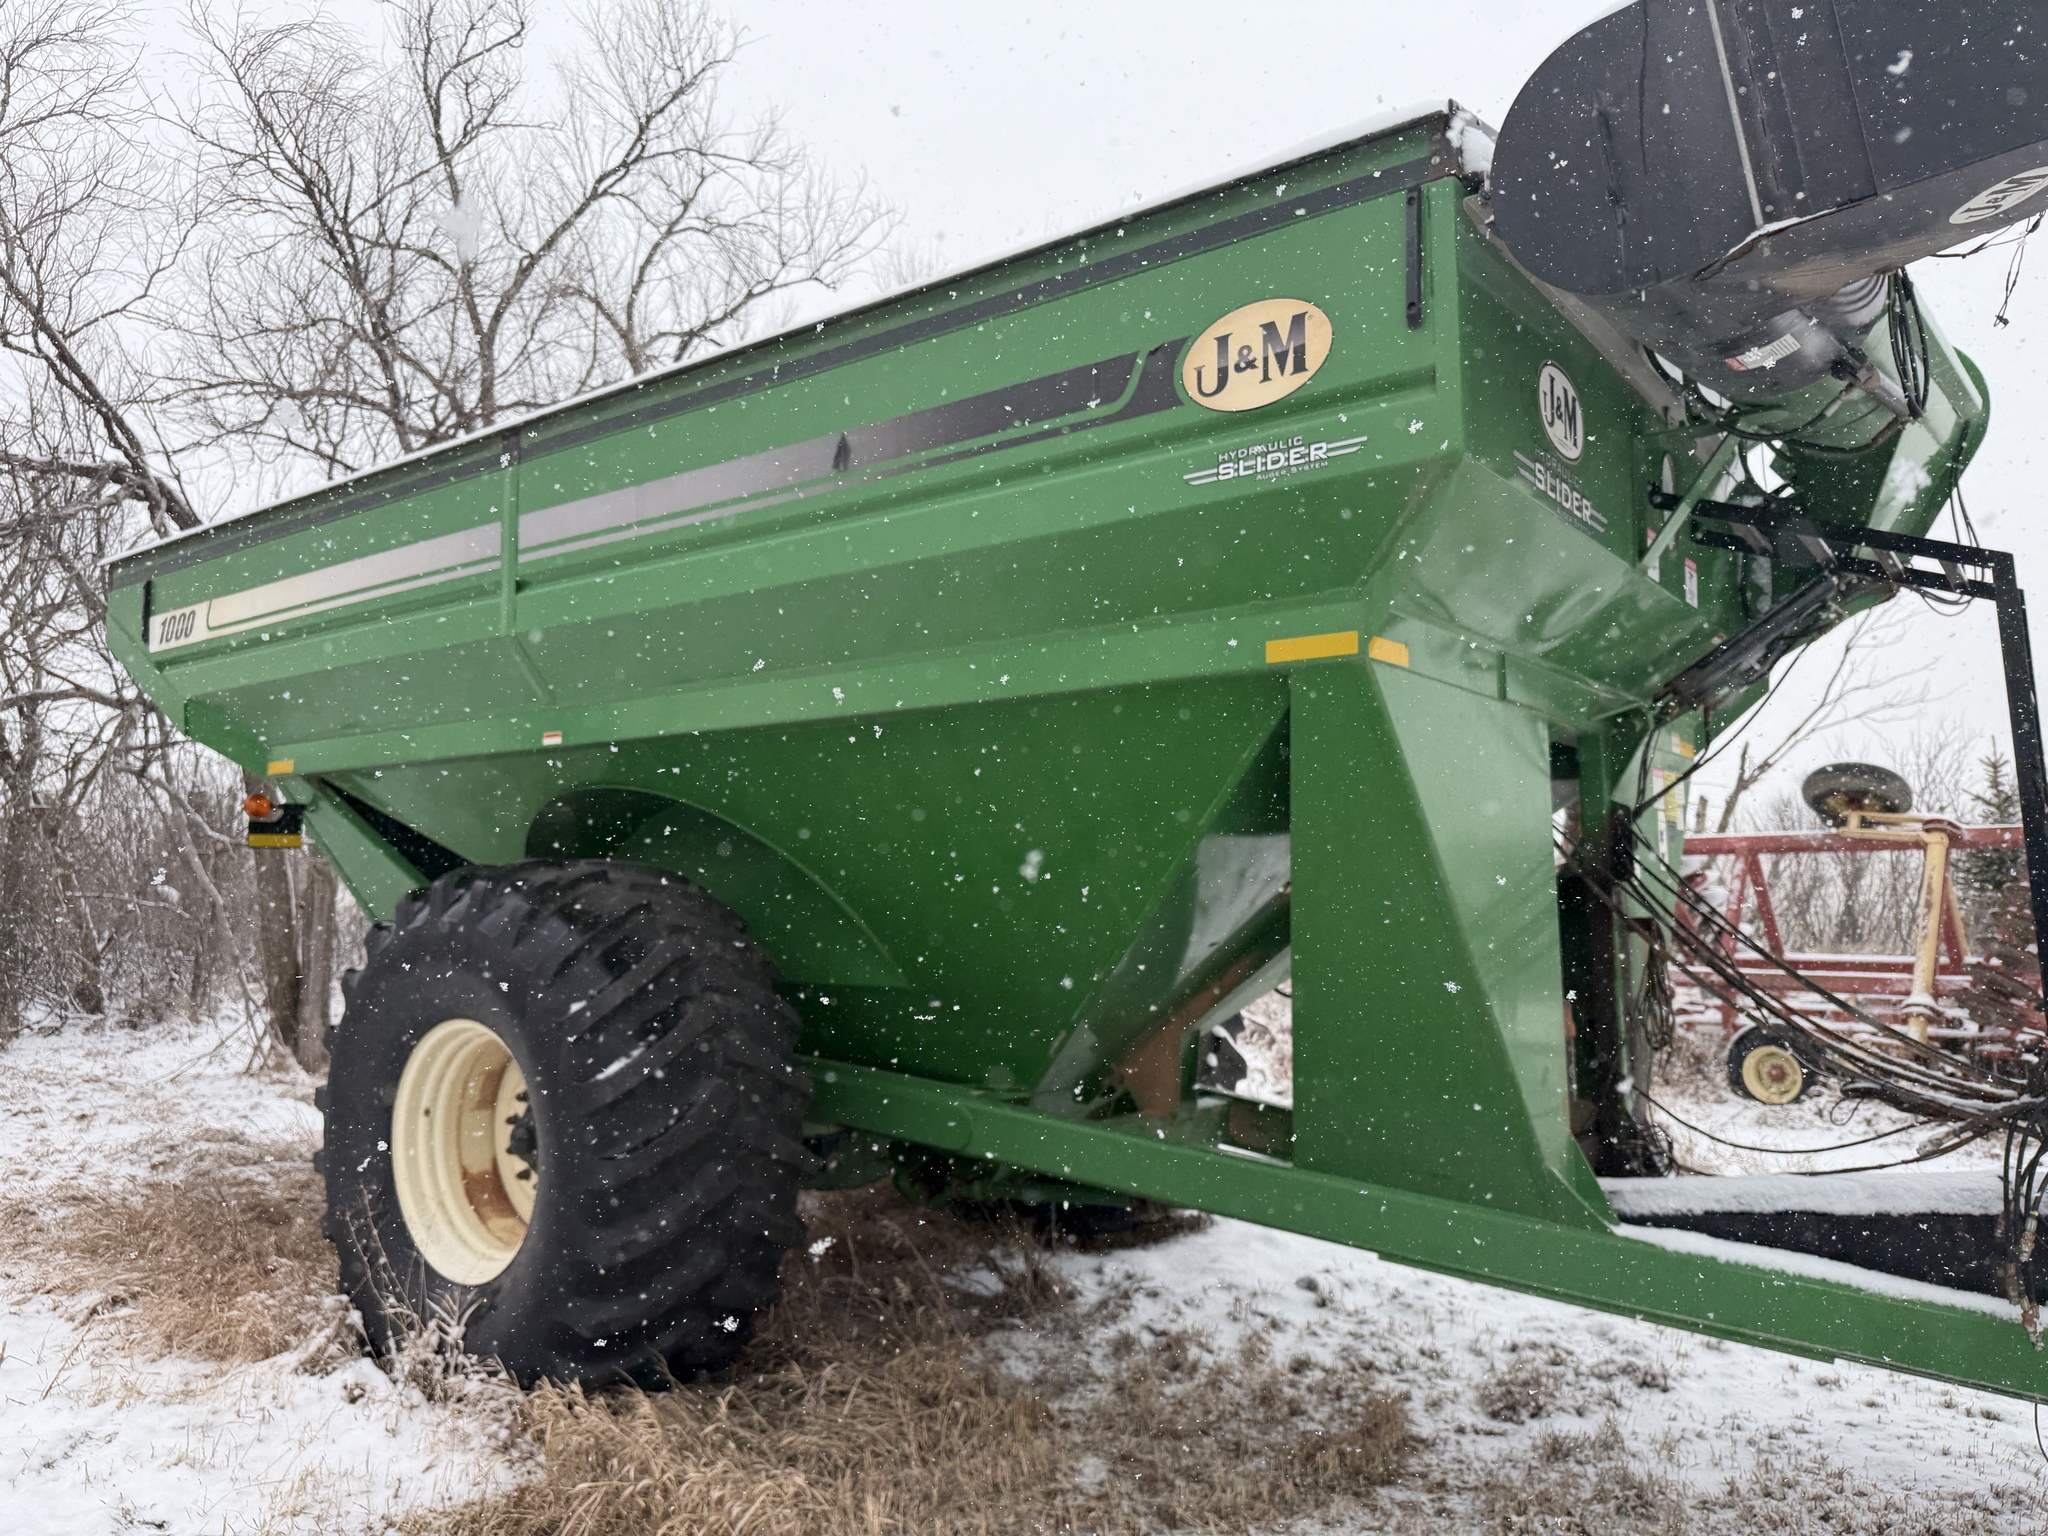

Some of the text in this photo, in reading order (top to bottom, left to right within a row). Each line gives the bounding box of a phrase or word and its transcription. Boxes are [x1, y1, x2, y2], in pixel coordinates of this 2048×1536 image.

[1193, 311, 1309, 398] J&M
[1543, 372, 1578, 449] J&M
[1217, 442, 1329, 481] SLIDER
[1218, 436, 1303, 462] HYDRAULIC
[1535, 462, 1592, 526] SLIDER
[159, 610, 197, 644] 1000
